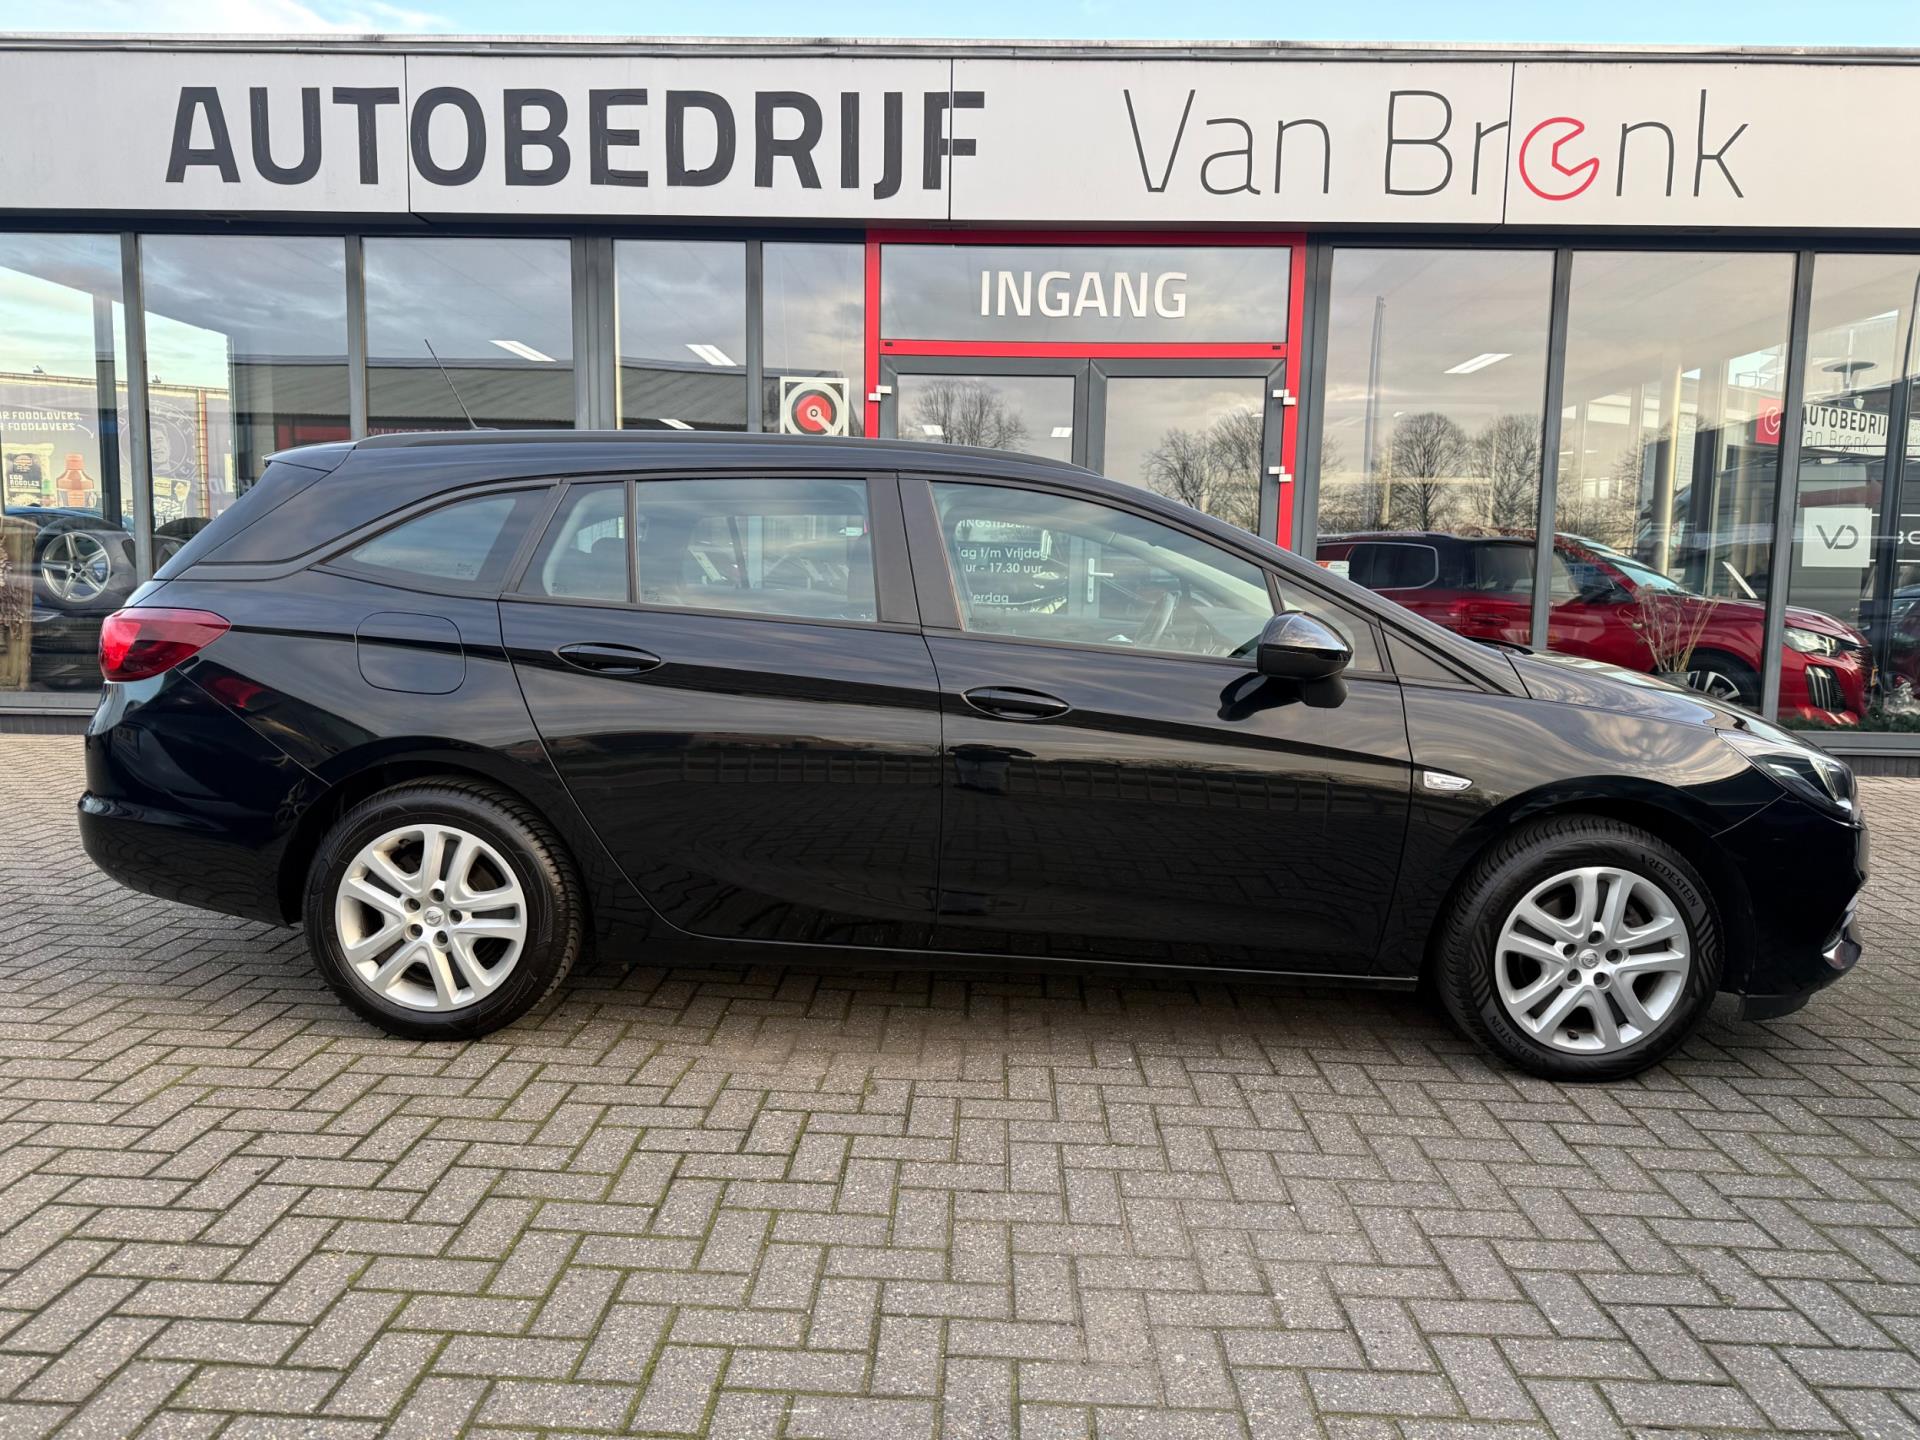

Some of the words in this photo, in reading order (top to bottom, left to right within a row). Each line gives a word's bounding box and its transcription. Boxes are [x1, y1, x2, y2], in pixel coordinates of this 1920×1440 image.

[165, 86, 985, 200] AUTOBEDRIJF
[1123, 88, 1261, 195] Van
[980, 270, 1187, 318] INGANG
[1801, 405, 1888, 436] AUTOBEDRIJ
[990, 562, 1020, 573] 17.30
[1023, 565, 1042, 573] uur
[970, 592, 1009, 603] erdag
